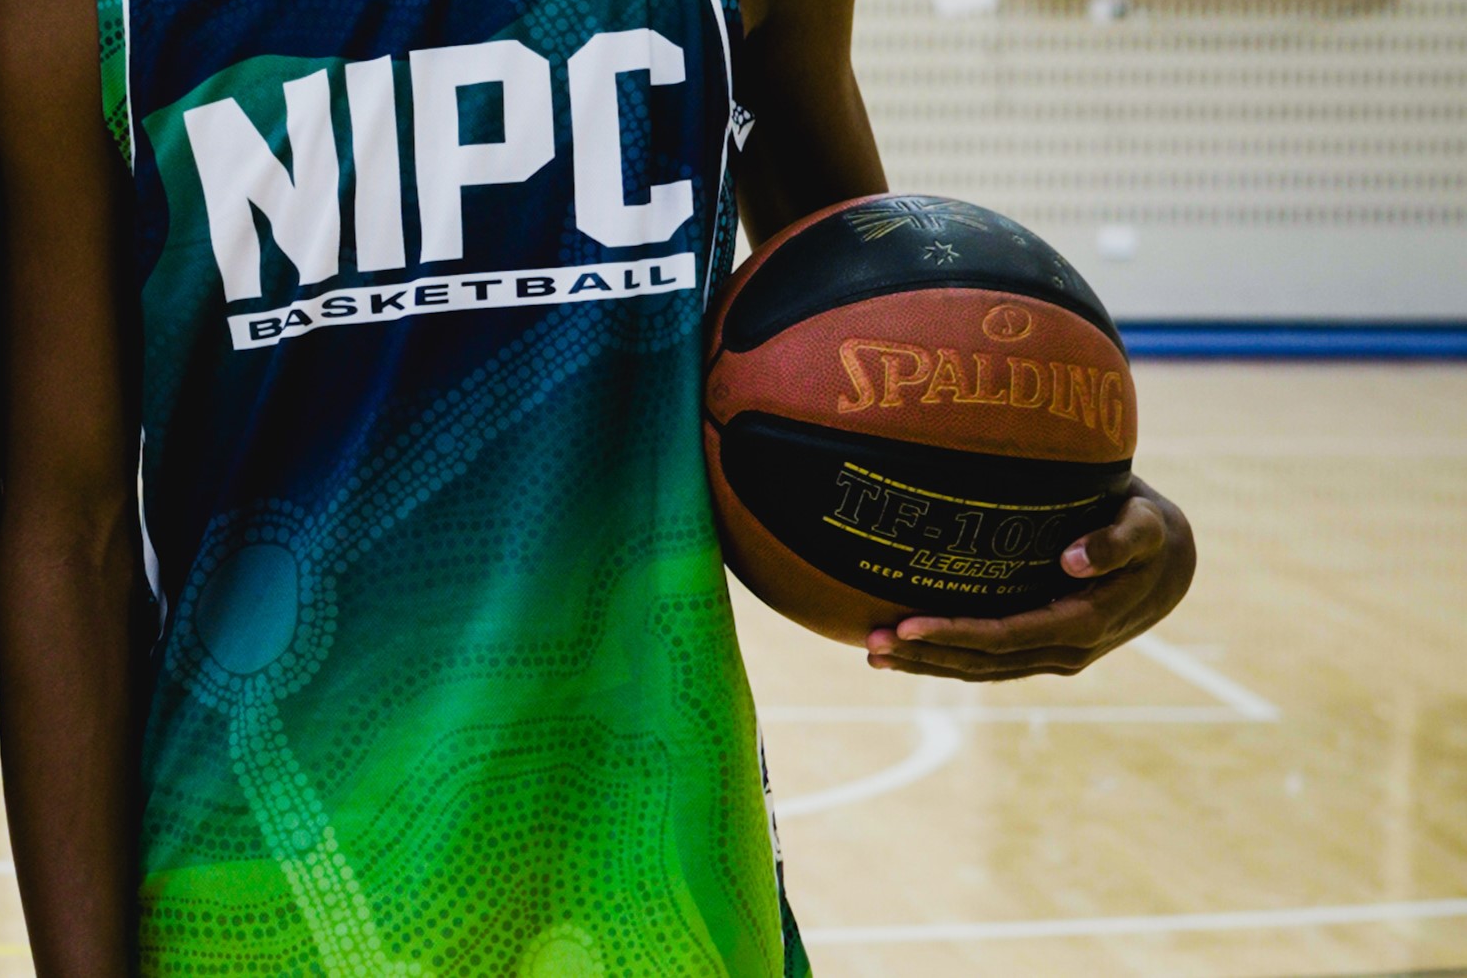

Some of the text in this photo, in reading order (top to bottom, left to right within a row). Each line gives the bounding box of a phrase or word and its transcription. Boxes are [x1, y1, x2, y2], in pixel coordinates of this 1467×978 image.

[183, 28, 694, 303] NIPC
[248, 264, 678, 342] BASKETBALL
[837, 338, 1125, 448] SPALDING
[859, 560, 904, 580] DEEP
[910, 575, 989, 596] CHANNEL
[909, 549, 1025, 580] LEGACY
